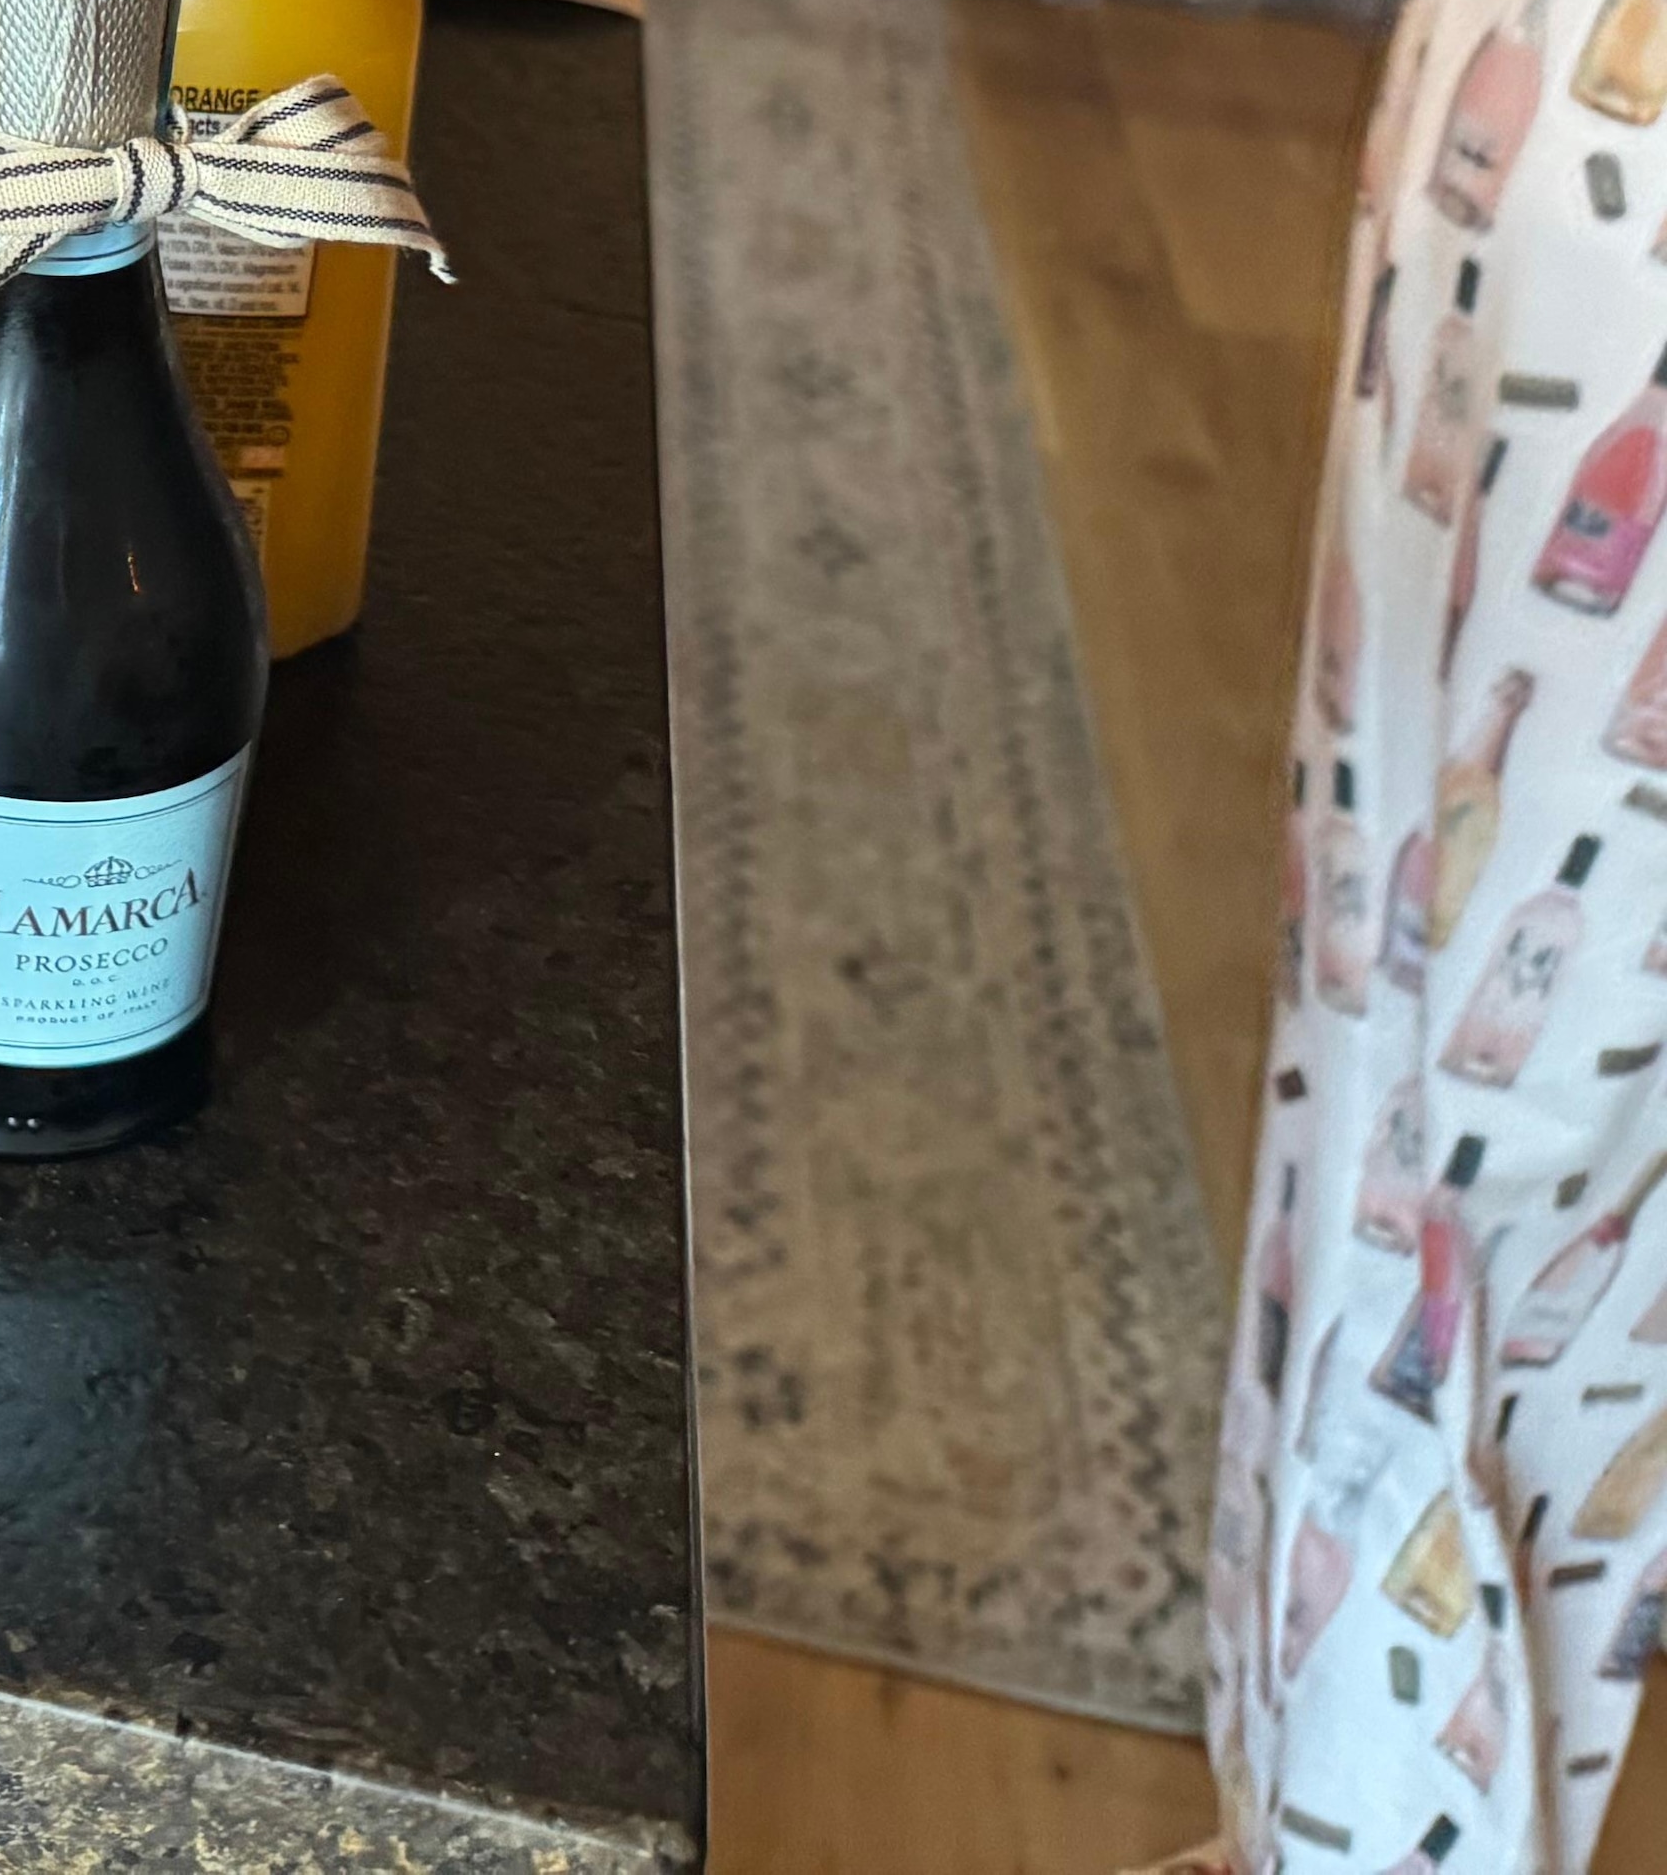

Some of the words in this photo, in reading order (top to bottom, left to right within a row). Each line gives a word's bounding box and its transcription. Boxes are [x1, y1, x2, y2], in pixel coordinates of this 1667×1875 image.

[16, 936, 169, 974] PROSECCO
[0, 993, 118, 1012] SPARKLING
[126, 977, 171, 1001] WINE
